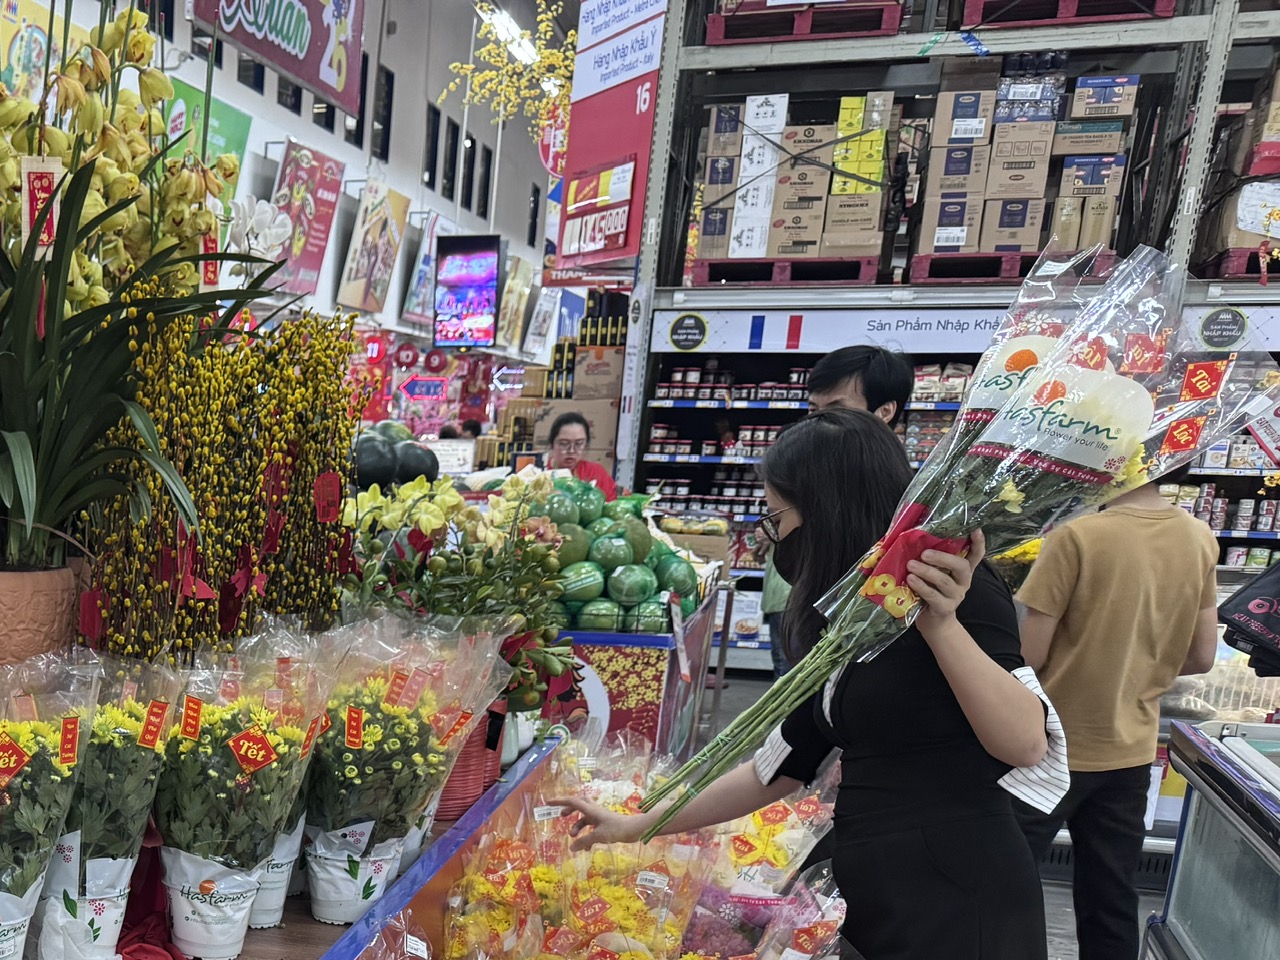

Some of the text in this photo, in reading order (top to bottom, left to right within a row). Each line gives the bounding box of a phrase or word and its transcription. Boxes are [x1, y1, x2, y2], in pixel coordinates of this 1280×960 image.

[636, 82, 651, 115] 16
[867, 316, 893, 332] Sản
[895, 316, 933, 332] Phẩm
[935, 318, 970, 335] Nhập
[366, 343, 380, 358] 11
[399, 350, 414, 363] 10
[430, 356, 439, 367] 9
[1190, 369, 1213, 394] Tài
[1044, 427, 1109, 451] Flower your life
[1172, 423, 1193, 445] Lộc
[239, 739, 267, 762] Tết
[180, 885, 248, 906] Hasfarm
